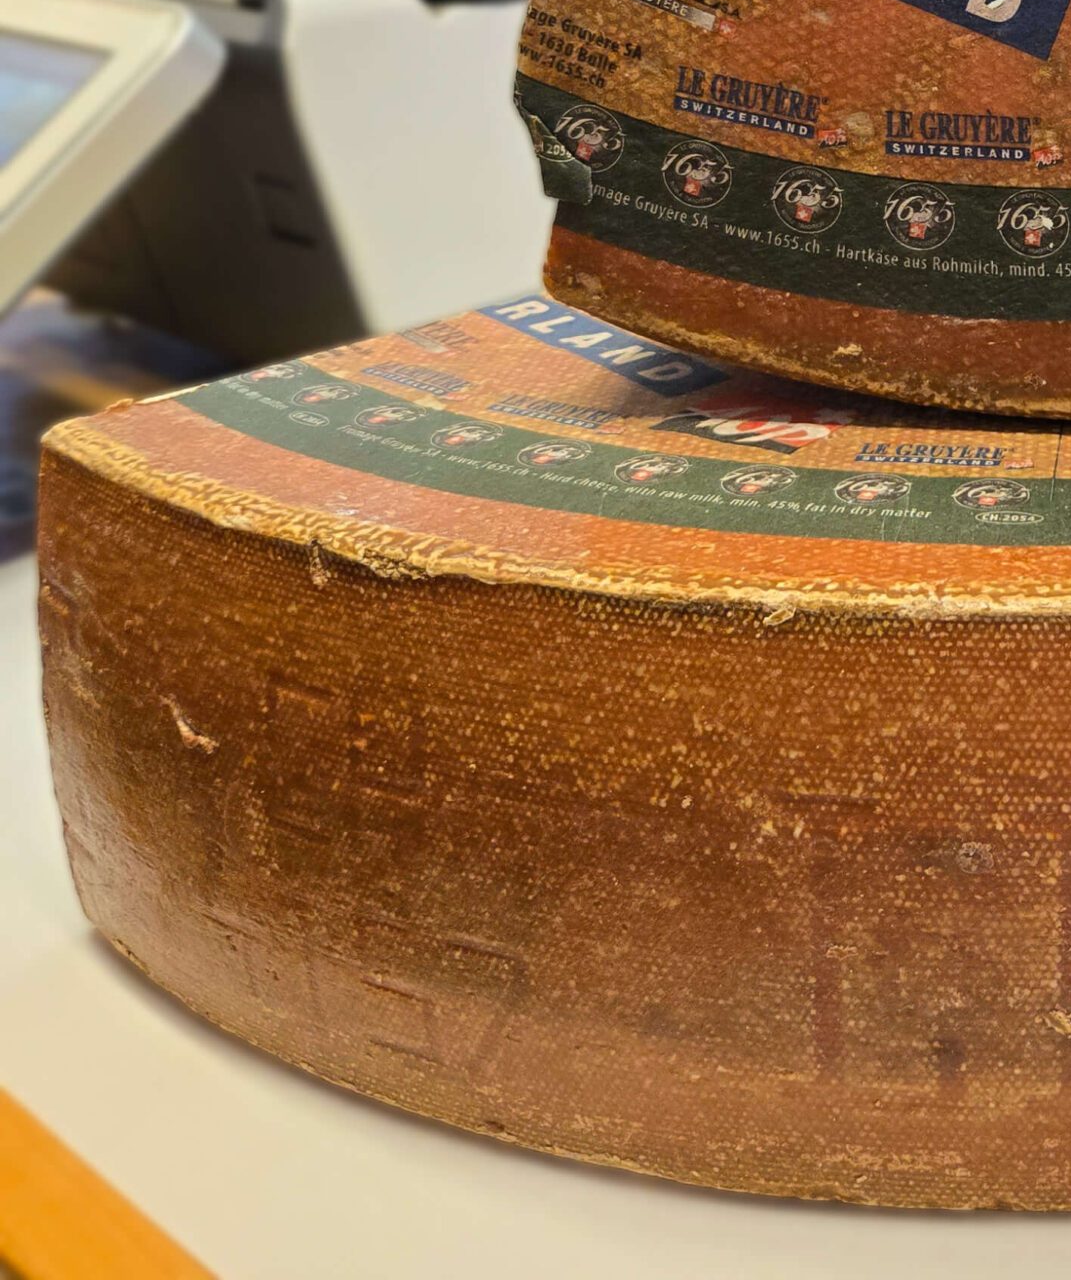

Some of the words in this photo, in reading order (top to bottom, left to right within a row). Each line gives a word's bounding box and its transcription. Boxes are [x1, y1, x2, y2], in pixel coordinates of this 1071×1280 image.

[527, 5, 558, 27] age
[623, 42, 644, 61] SA
[538, 31, 575, 57] 1630
[577, 45, 619, 74] Bulle
[675, 65, 705, 97] LE
[553, 116, 628, 152] 1655
[679, 98, 810, 137] SWITZERLAND
[884, 109, 915, 140] LE
[891, 141, 1026, 161] SWITZERLAND
[660, 152, 736, 186] 1655
[770, 178, 846, 210] 1655
[882, 194, 957, 224] 1655
[591, 183, 631, 206] mage
[691, 211, 709, 230] SA
[724, 222, 822, 255] www.1655.ch
[836, 243, 899, 268] Hartkäse
[903, 255, 928, 270] aus
[932, 257, 1004, 280] Rohmilch,
[1008, 261, 1051, 278] mind.
[995, 201, 1070, 232] 1655
[495, 299, 695, 381] RLAND
[860, 442, 889, 455] LE
[539, 471, 576, 485] Hard
[624, 485, 657, 496] with
[658, 489, 688, 500] raw
[688, 492, 725, 506] milk,
[729, 496, 761, 508] min.
[804, 501, 829, 513] fat
[830, 504, 846, 515] in
[850, 505, 877, 518] dry
[880, 507, 933, 520] matter
